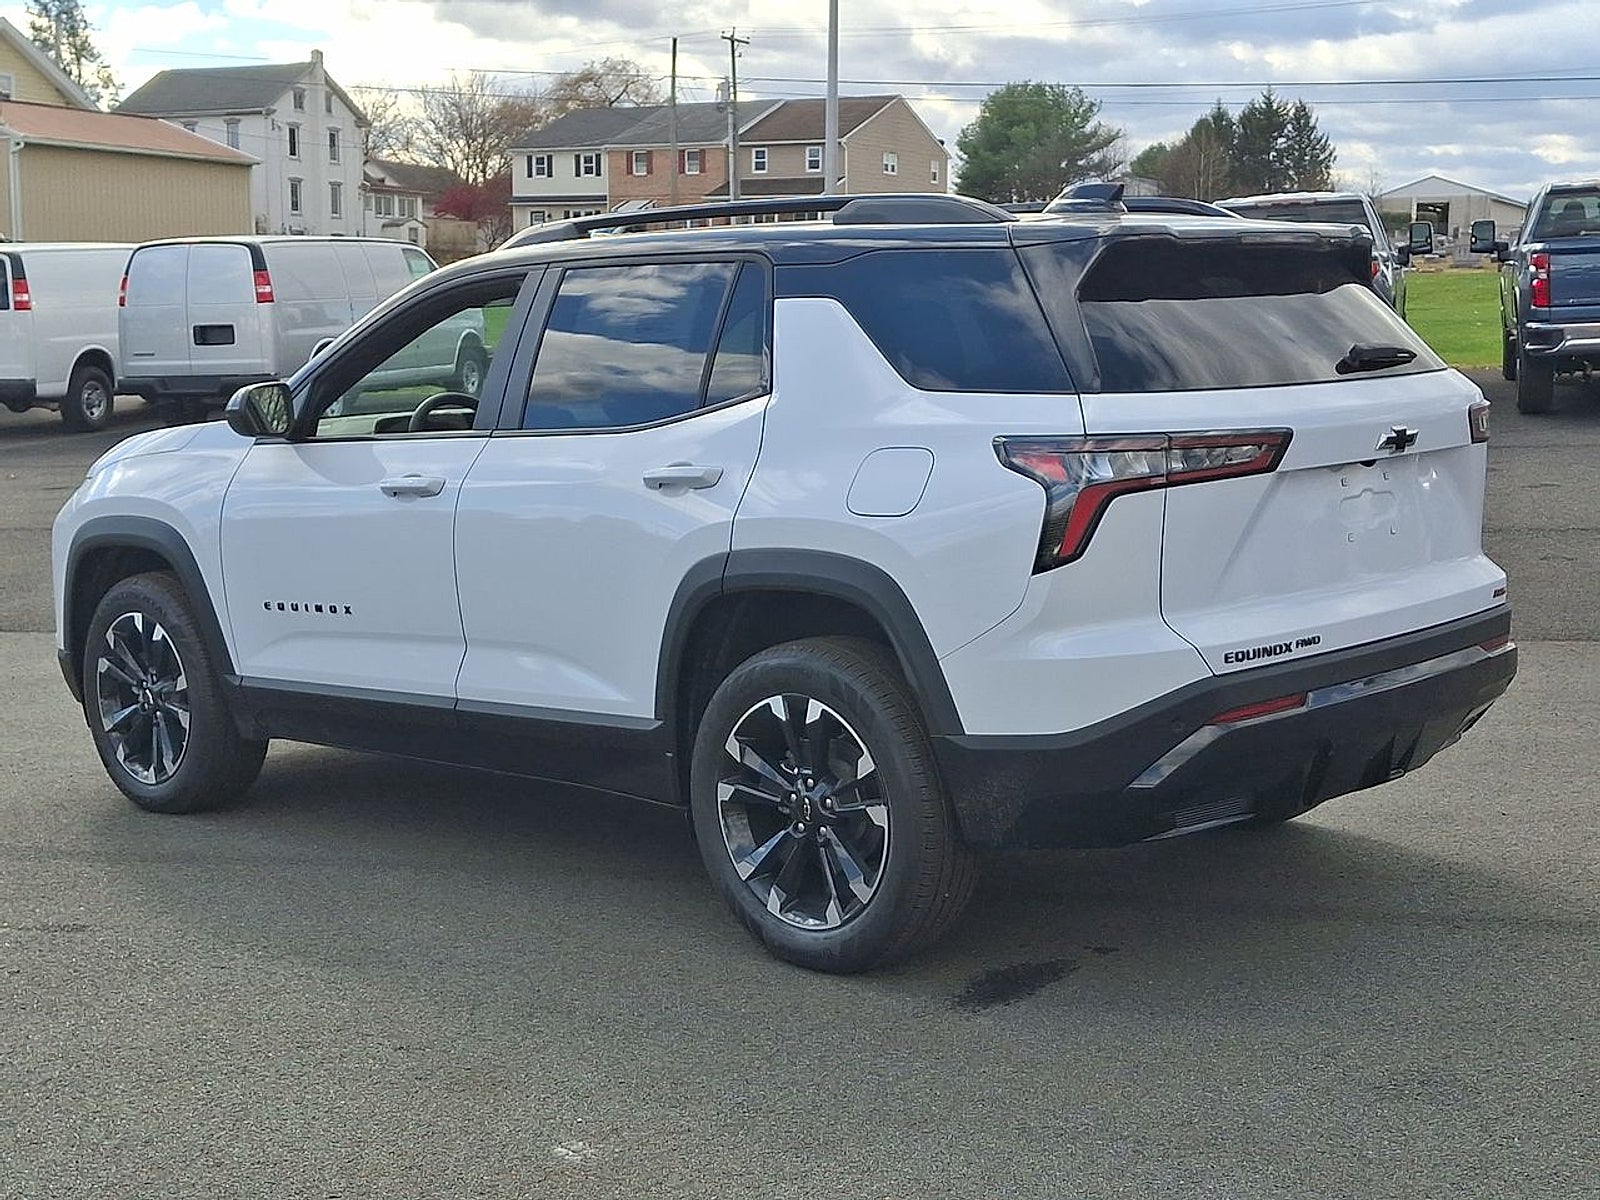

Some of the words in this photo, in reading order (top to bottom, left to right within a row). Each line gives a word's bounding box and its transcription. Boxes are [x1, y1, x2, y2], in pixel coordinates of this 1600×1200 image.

[263, 601, 352, 615] EQUINOX
[1223, 641, 1293, 664] EQUINOX
[1295, 635, 1321, 649] AWD
